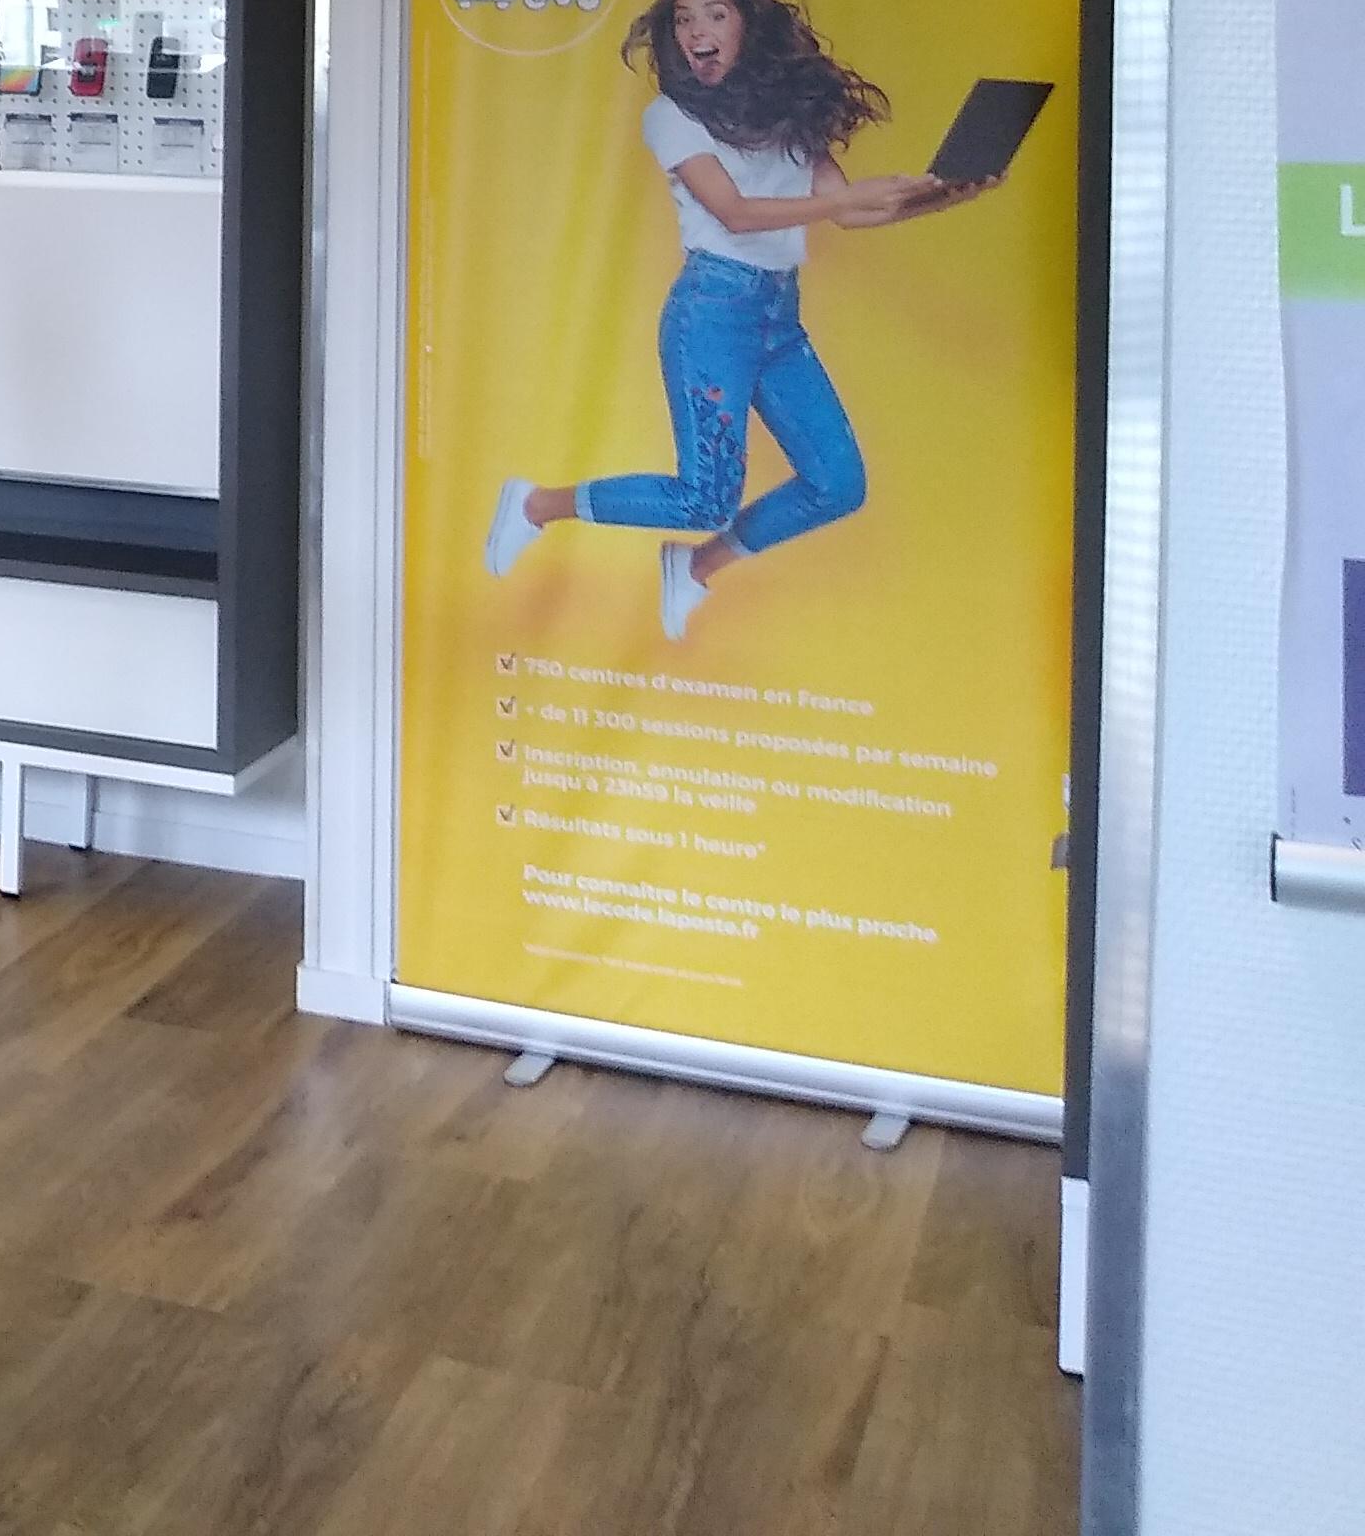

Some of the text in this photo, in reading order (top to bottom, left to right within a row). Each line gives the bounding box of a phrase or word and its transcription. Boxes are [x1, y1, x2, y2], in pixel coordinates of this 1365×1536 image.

[524, 656, 564, 678] 750
[569, 664, 646, 689] centres
[763, 687, 792, 705] en
[798, 689, 874, 716] France
[540, 703, 566, 723] de
[595, 709, 636, 731] 300
[641, 717, 729, 744] sessions
[735, 730, 850, 760] proposées
[855, 744, 893, 765] par
[898, 750, 998, 779] semaine
[648, 762, 766, 792] annulation
[771, 778, 800, 798] ou
[806, 783, 952, 818] modification
[673, 785, 693, 806] la
[699, 791, 757, 815] veille
[524, 808, 621, 840] Résultats
[625, 826, 675, 848] sous
[679, 830, 688, 849] 1
[523, 864, 938, 944] Pour connaître le centre le plus proche
